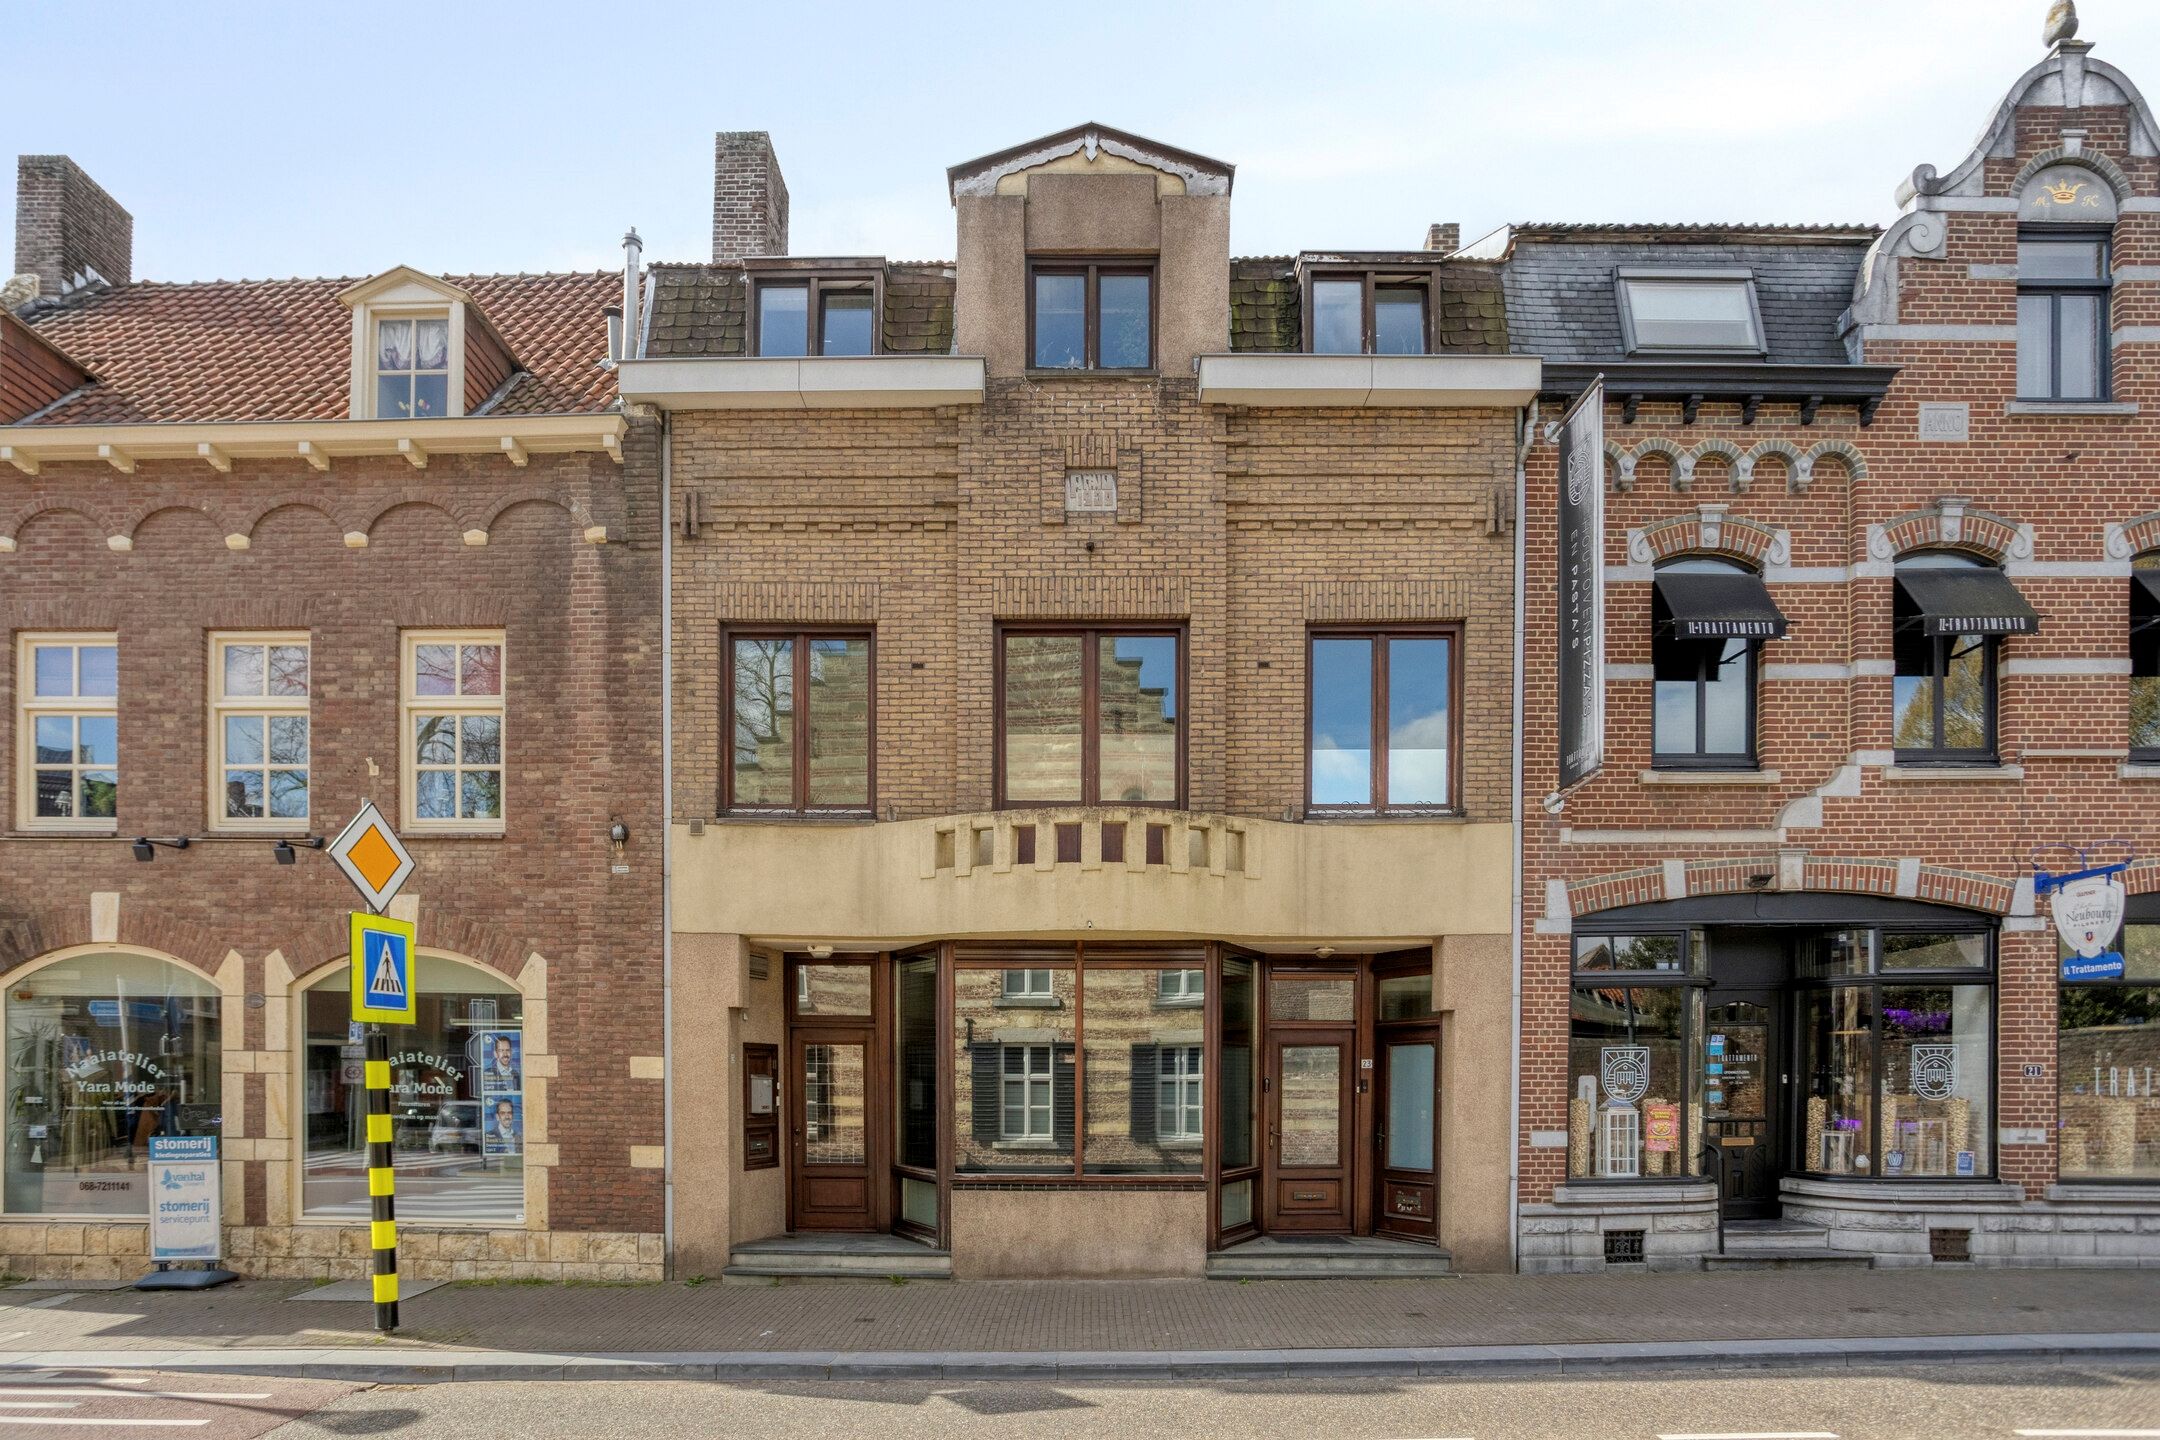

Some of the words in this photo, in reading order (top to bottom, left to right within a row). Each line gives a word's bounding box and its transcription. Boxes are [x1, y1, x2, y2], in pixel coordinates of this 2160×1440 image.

[2065, 907, 2112, 925] Neubourg
[2071, 961, 2122, 974] Trattamento
[65, 1050, 167, 1080] Naaiatelier
[389, 1051, 464, 1081] aiatelier
[2027, 1066, 2038, 1076] 21
[77, 1080, 111, 1093] Yara
[115, 1080, 156, 1094] Mode
[389, 1084, 410, 1094] ara
[414, 1082, 453, 1095] Mode
[155, 1138, 211, 1151] stomerij
[160, 1199, 210, 1215] stomerij
[160, 1214, 210, 1226] servicepunt
